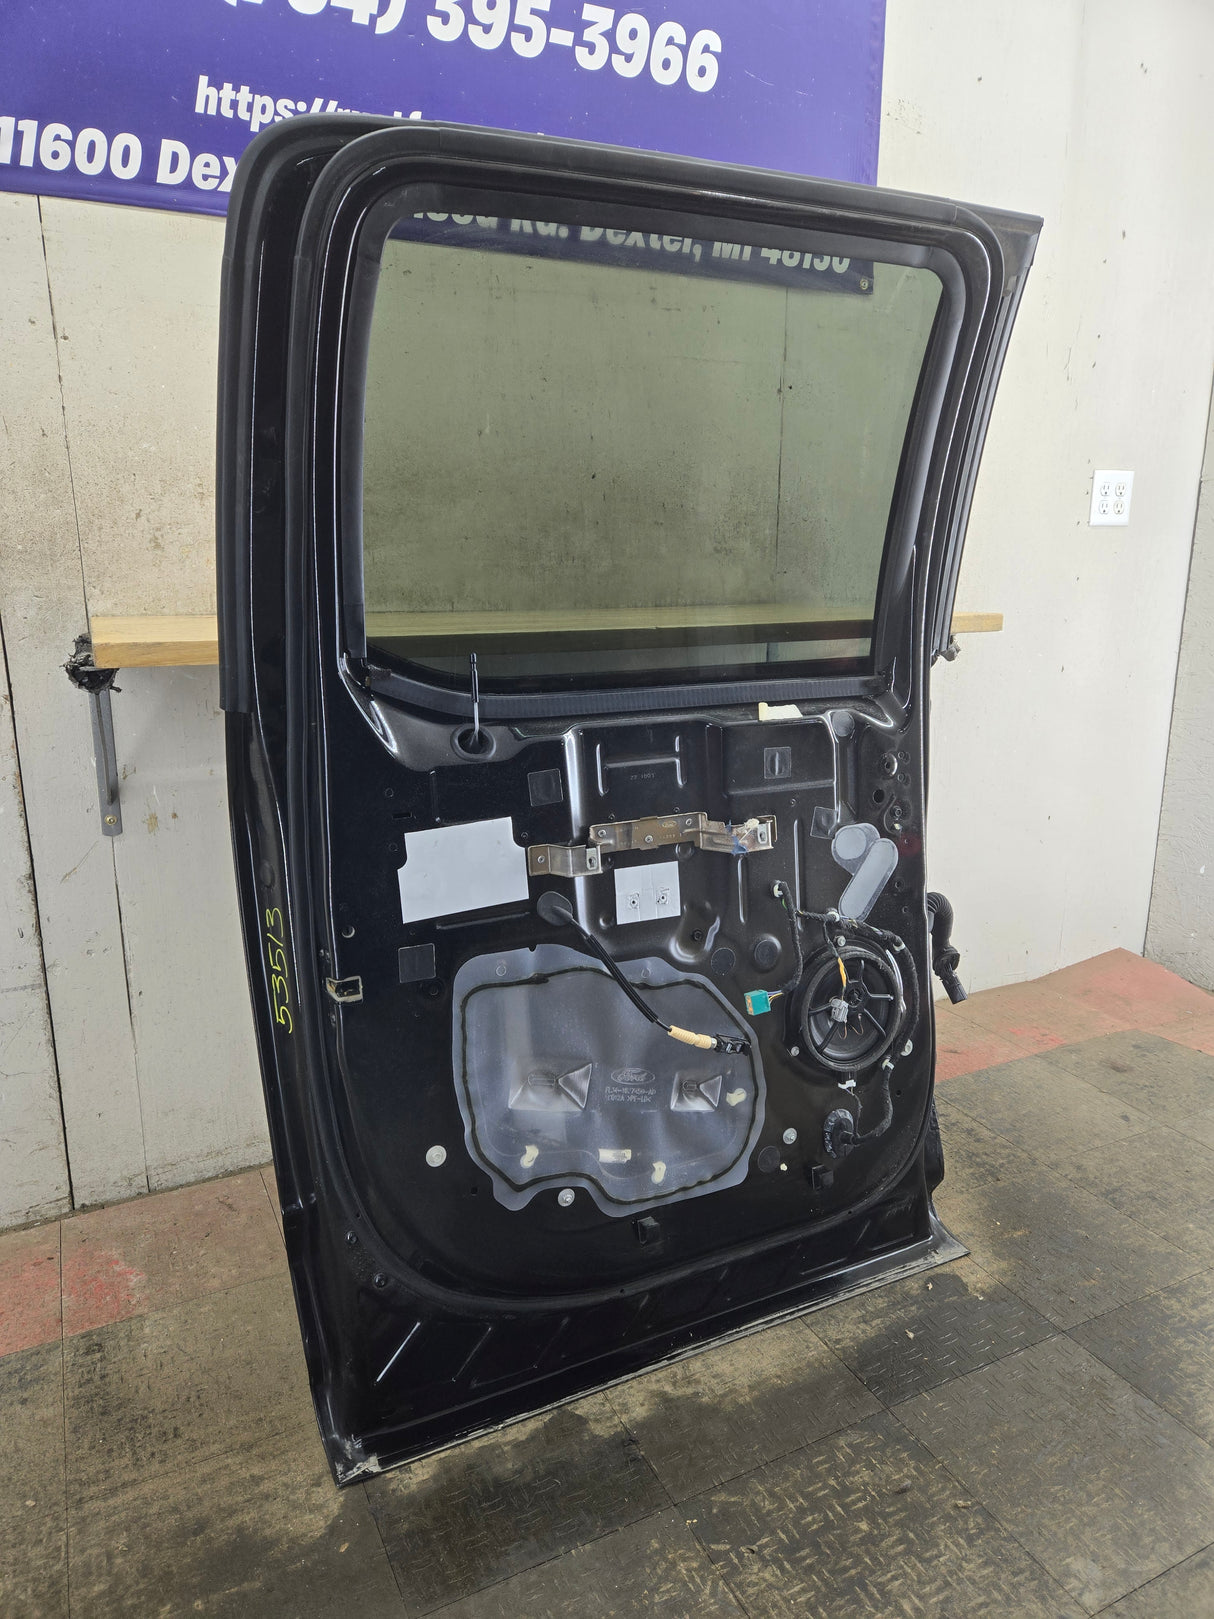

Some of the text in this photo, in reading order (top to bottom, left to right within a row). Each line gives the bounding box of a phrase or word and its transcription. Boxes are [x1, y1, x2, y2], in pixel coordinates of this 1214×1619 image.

[427, 0, 722, 92] 395-3966
[0, 116, 142, 180] 11600
[156, 138, 237, 192] Dex
